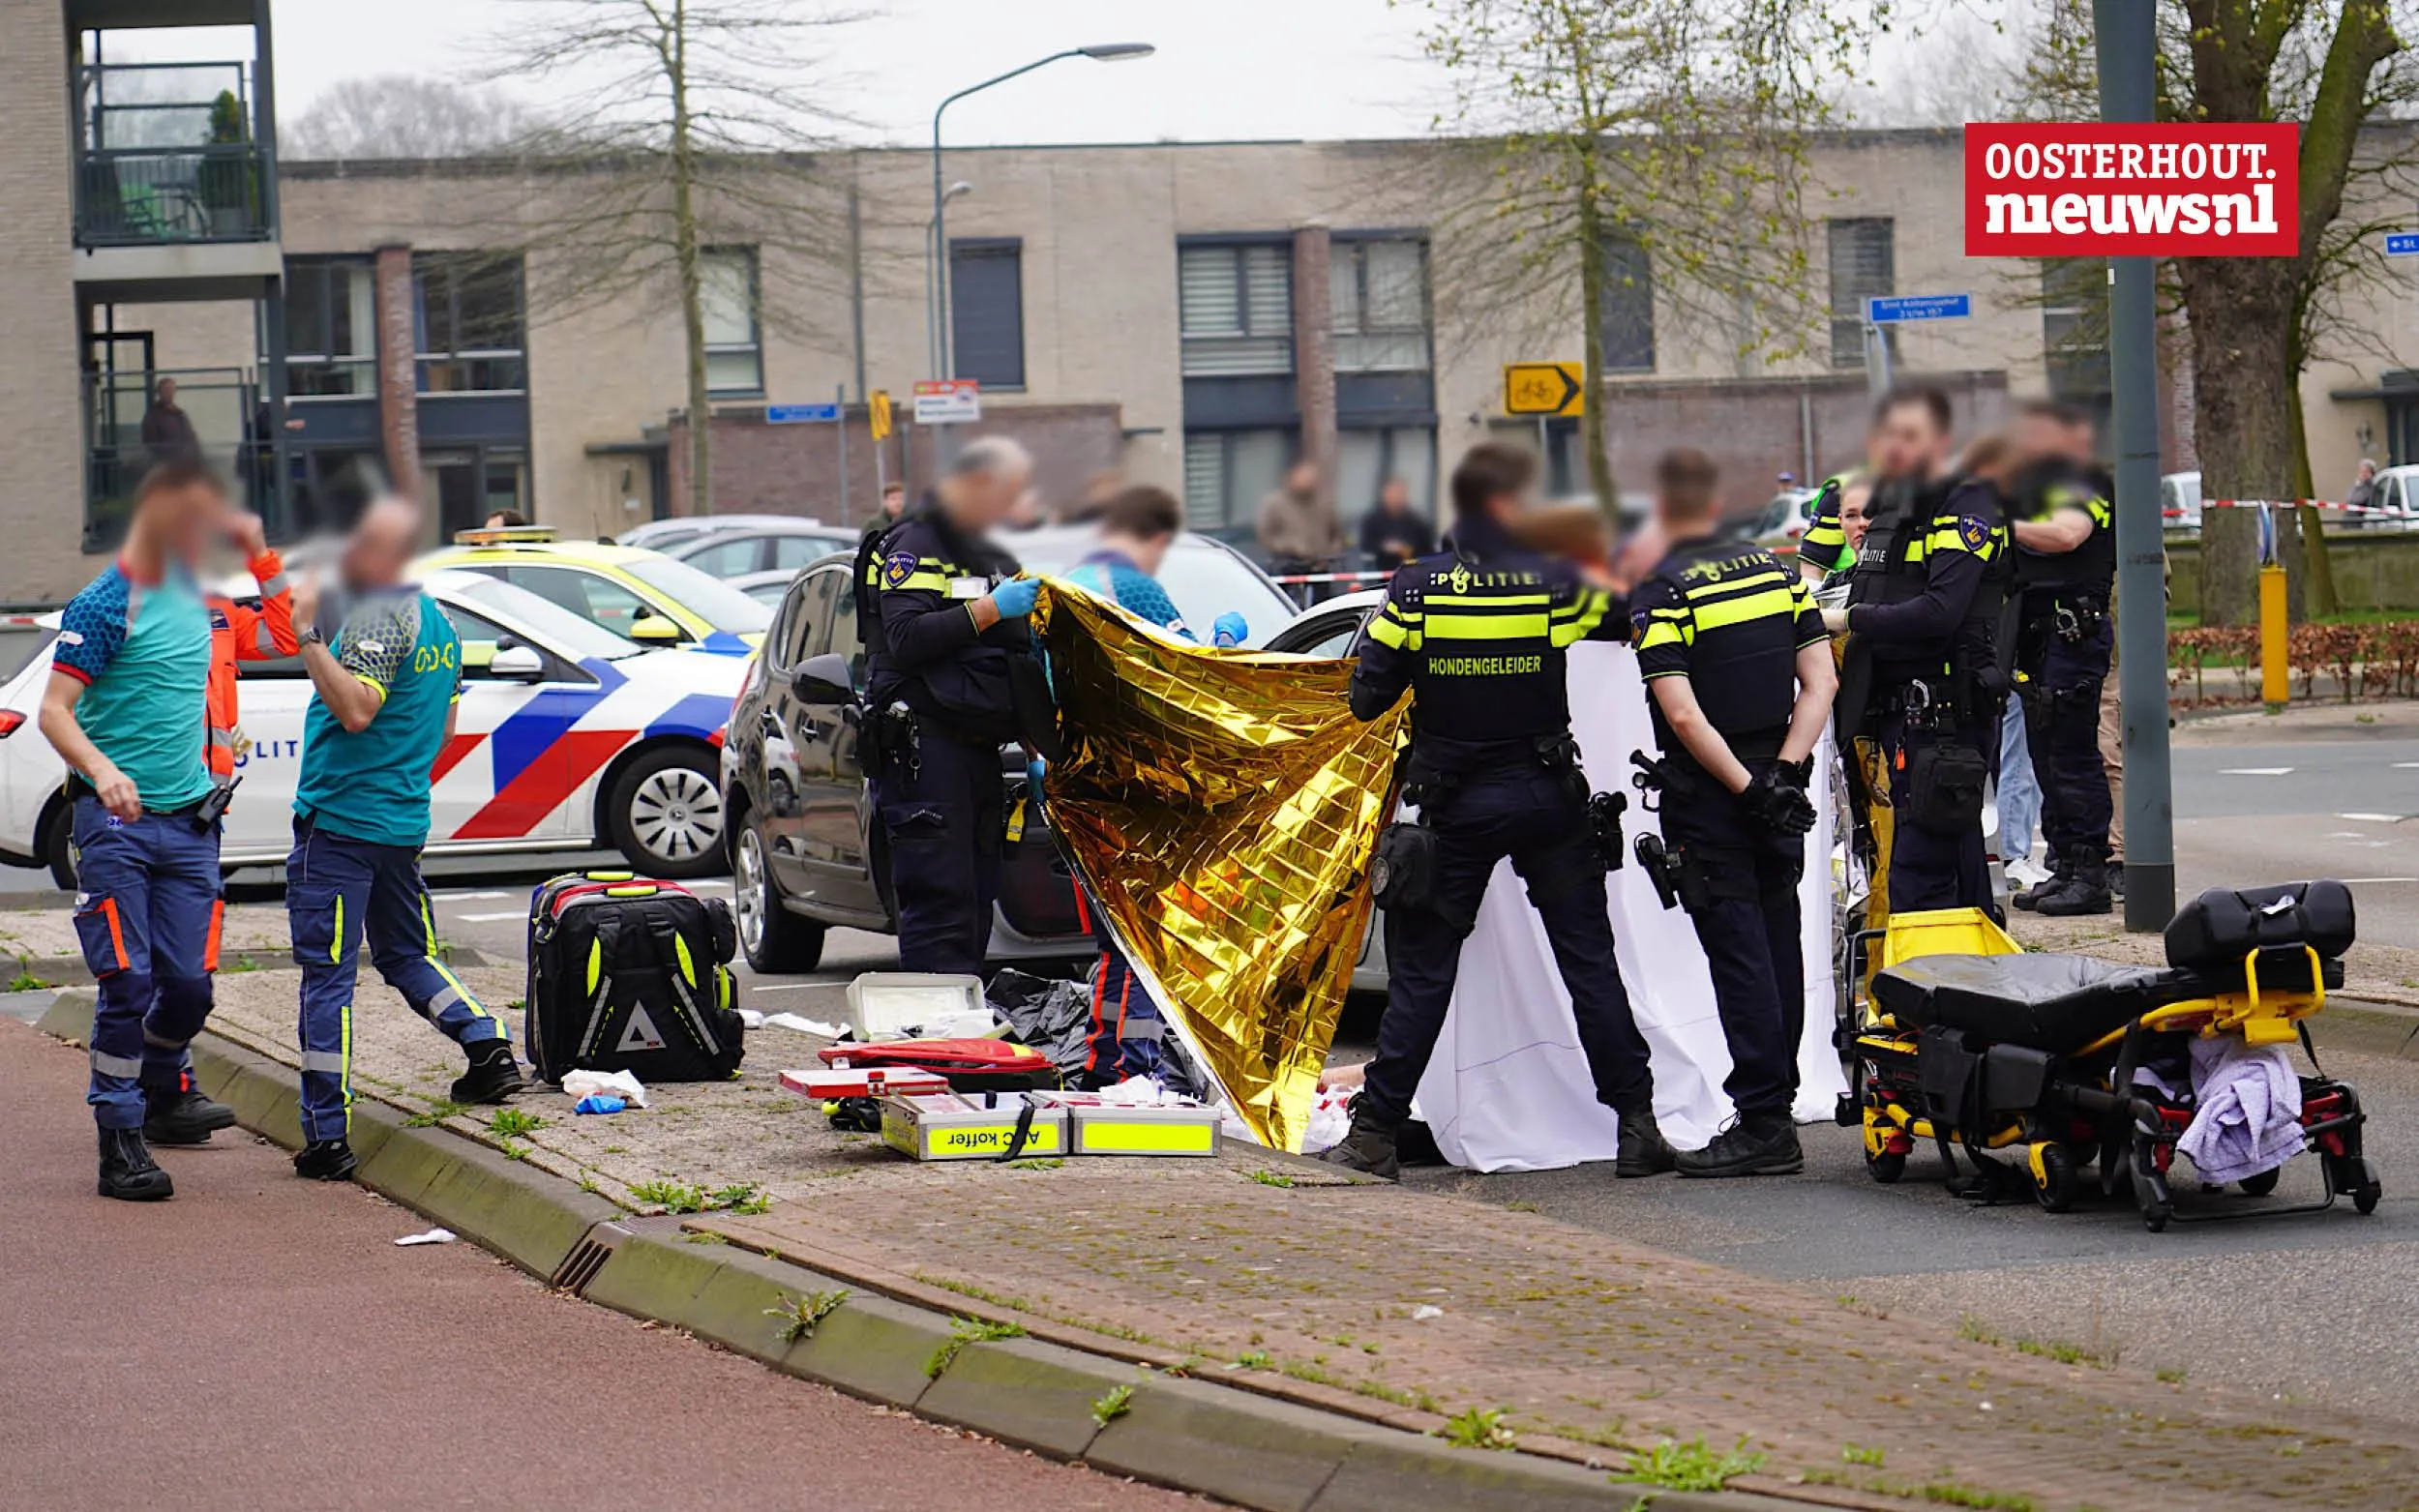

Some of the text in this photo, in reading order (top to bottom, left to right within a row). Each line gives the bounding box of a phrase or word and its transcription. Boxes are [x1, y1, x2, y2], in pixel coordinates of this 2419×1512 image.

[1687, 553, 1773, 581] POLITIE
[1437, 569, 1537, 594] POLITIE
[1428, 656, 1541, 675] HONDENGELEIDER
[948, 1131, 1040, 1147] AC koffer
